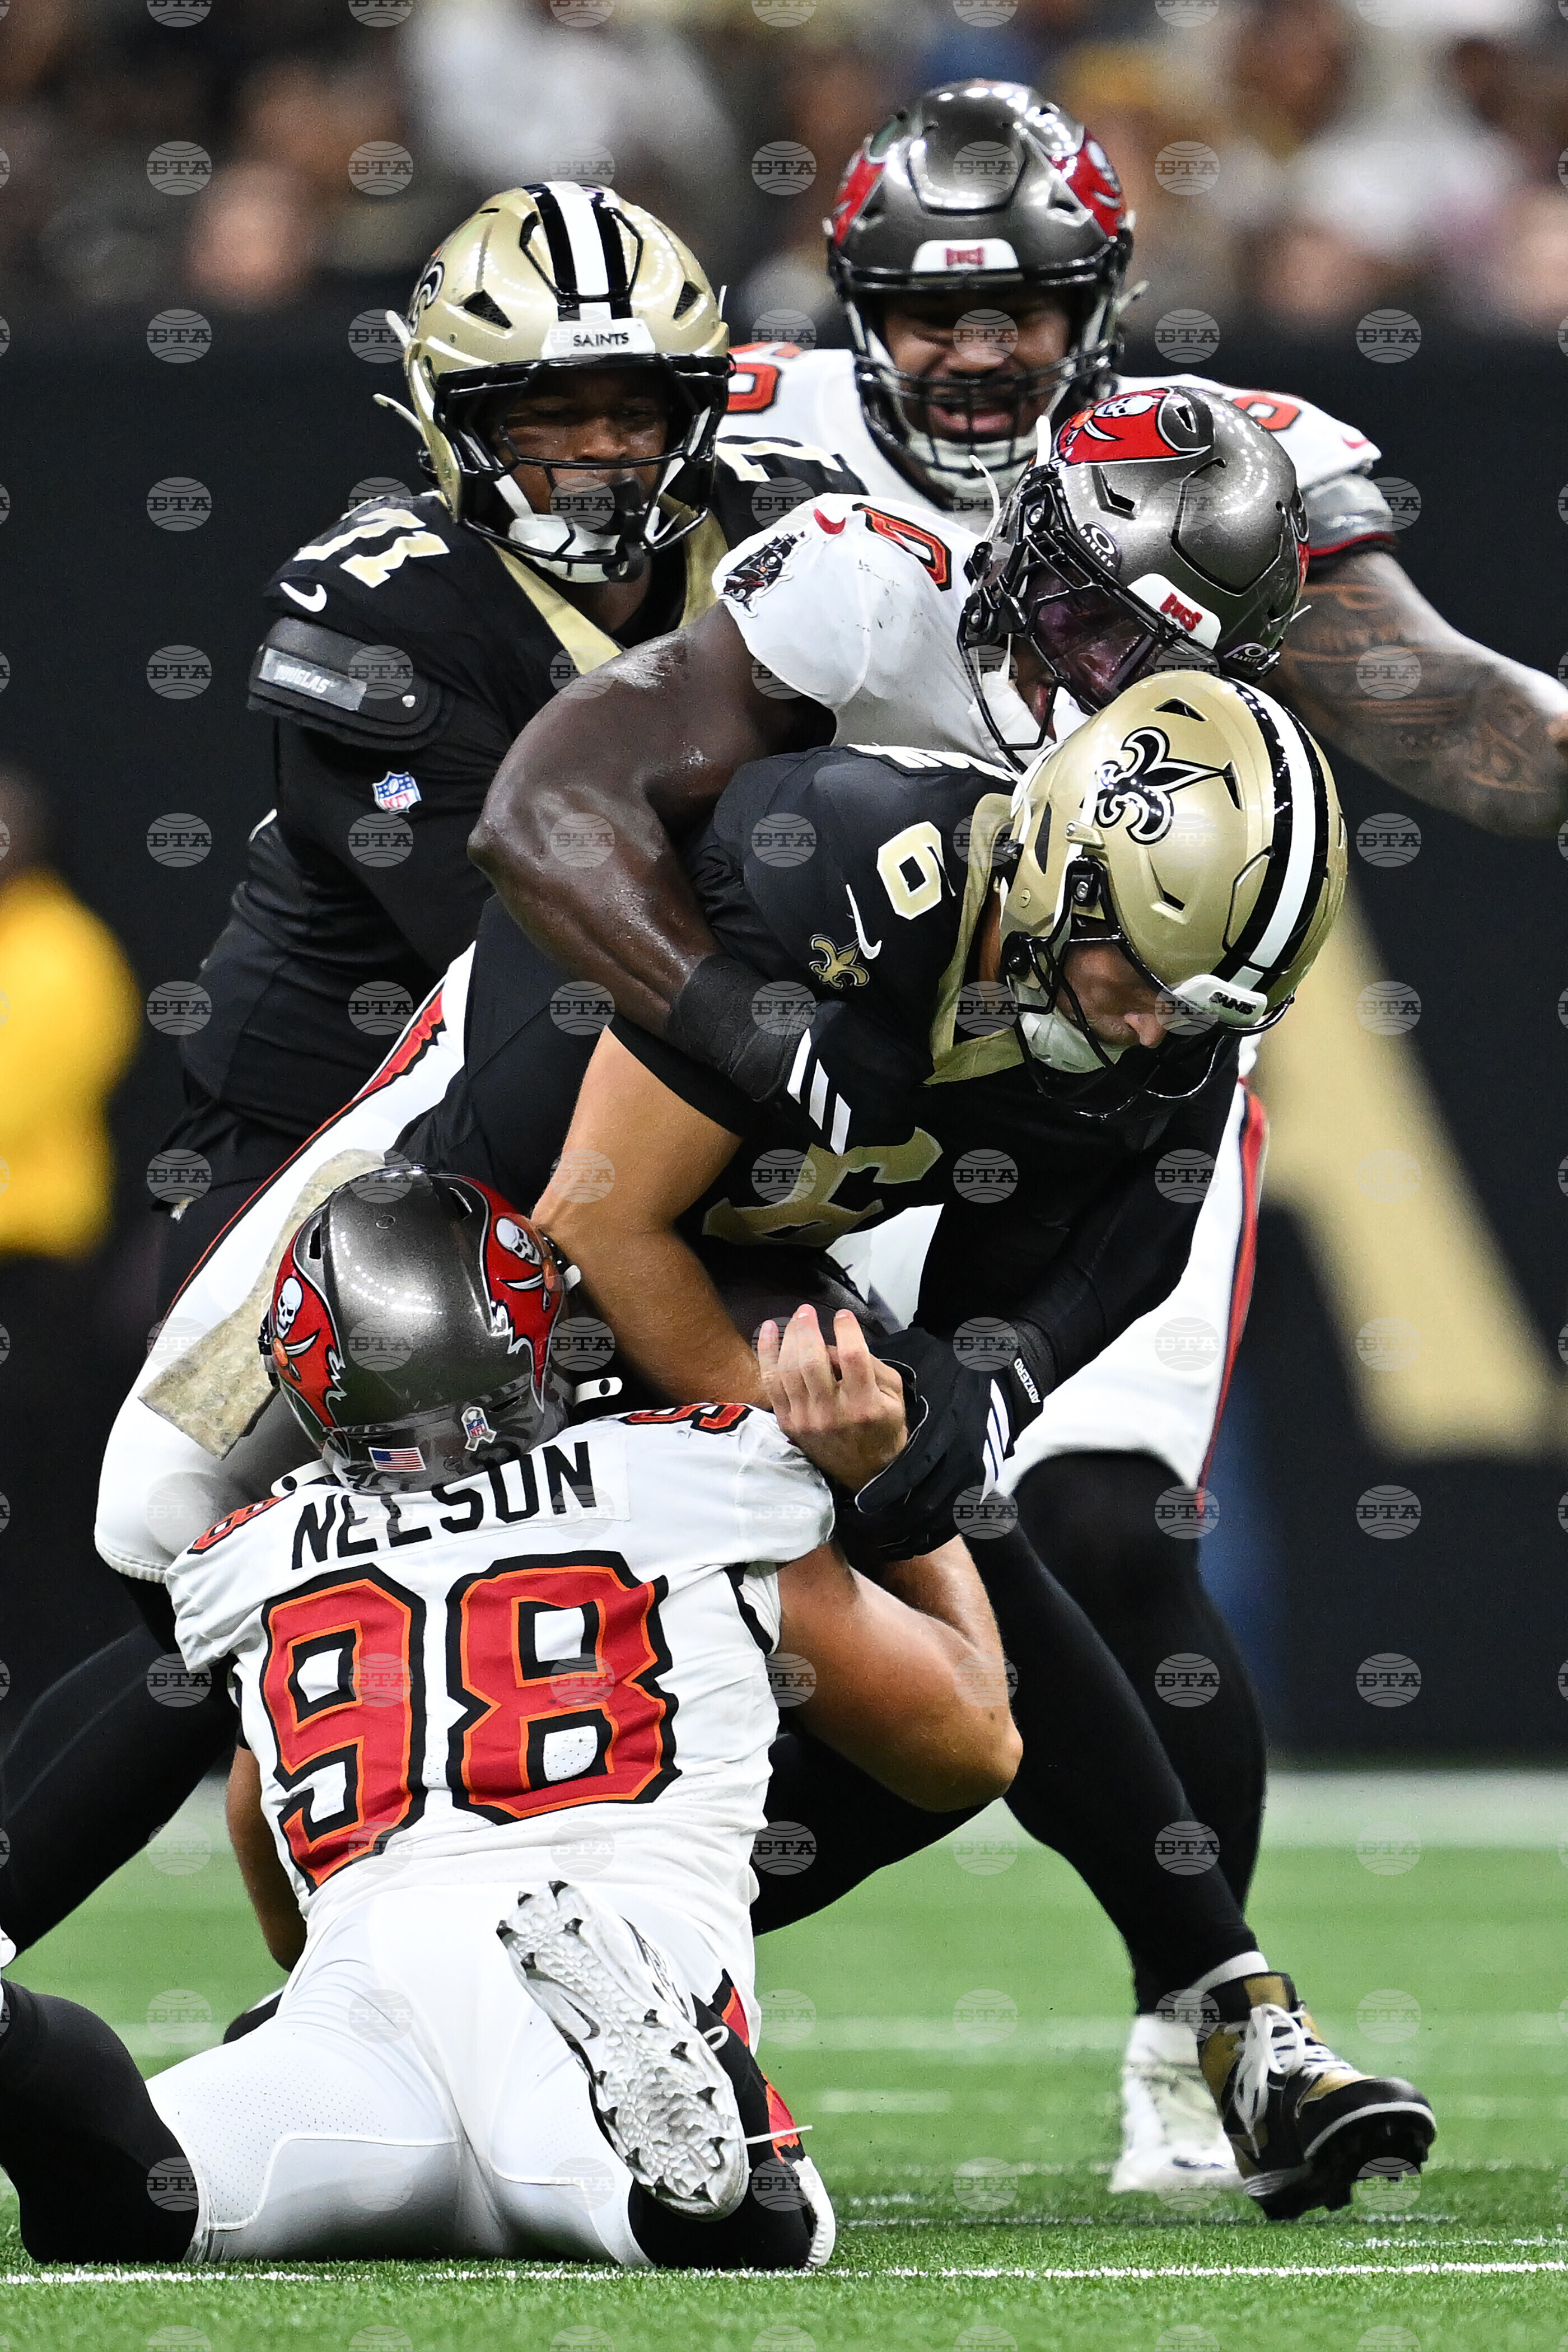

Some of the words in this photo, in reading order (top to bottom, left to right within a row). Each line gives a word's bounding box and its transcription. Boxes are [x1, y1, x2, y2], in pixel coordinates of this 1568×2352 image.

[573, 332, 629, 347] SAINTS
[876, 820, 956, 921] 6
[1014, 1357, 1041, 1404] ADIZERO
[470, 1425, 486, 1438] NFL
[291, 1441, 598, 1570] NELSON
[259, 1551, 683, 1897] 98
